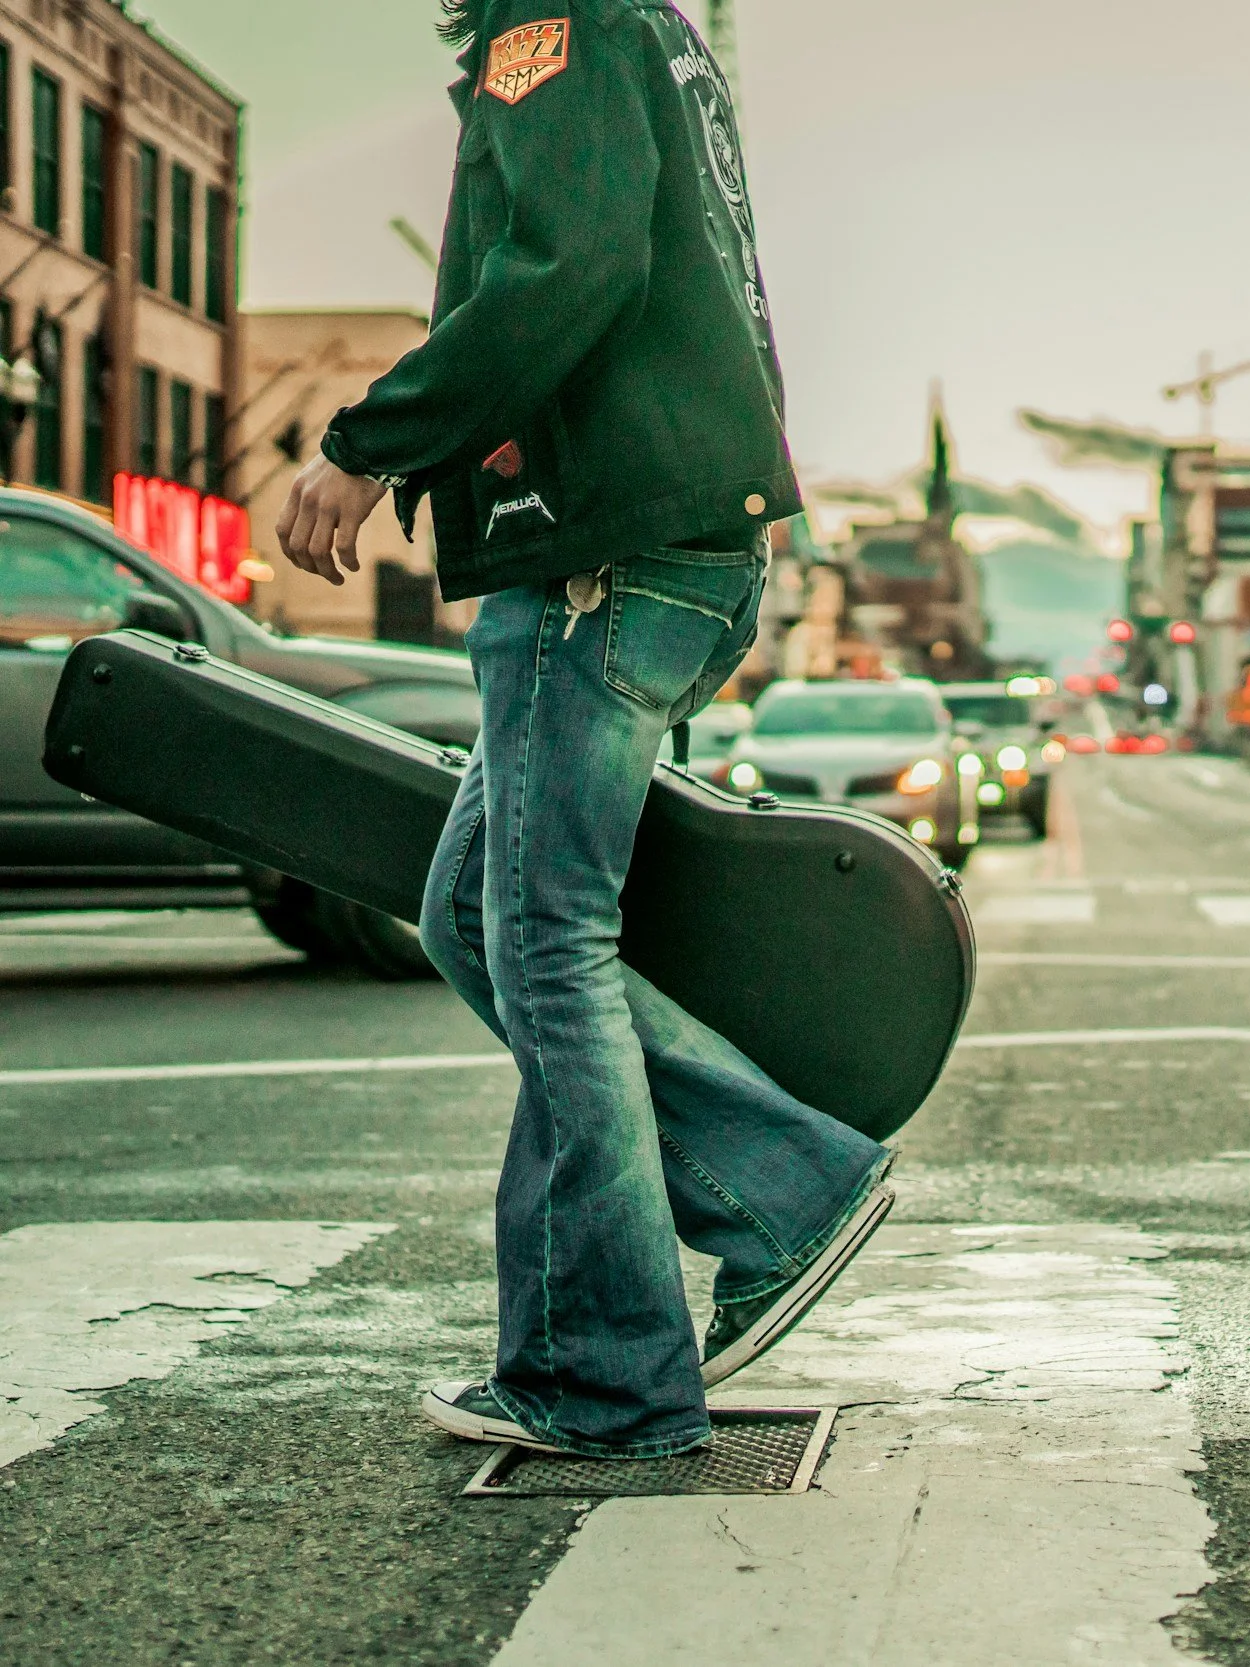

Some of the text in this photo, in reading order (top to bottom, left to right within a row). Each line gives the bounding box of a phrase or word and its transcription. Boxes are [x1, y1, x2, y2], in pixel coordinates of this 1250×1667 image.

[490, 25, 562, 74] KISS
[495, 64, 550, 99] ARMY
[485, 491, 556, 540] METALLICA
